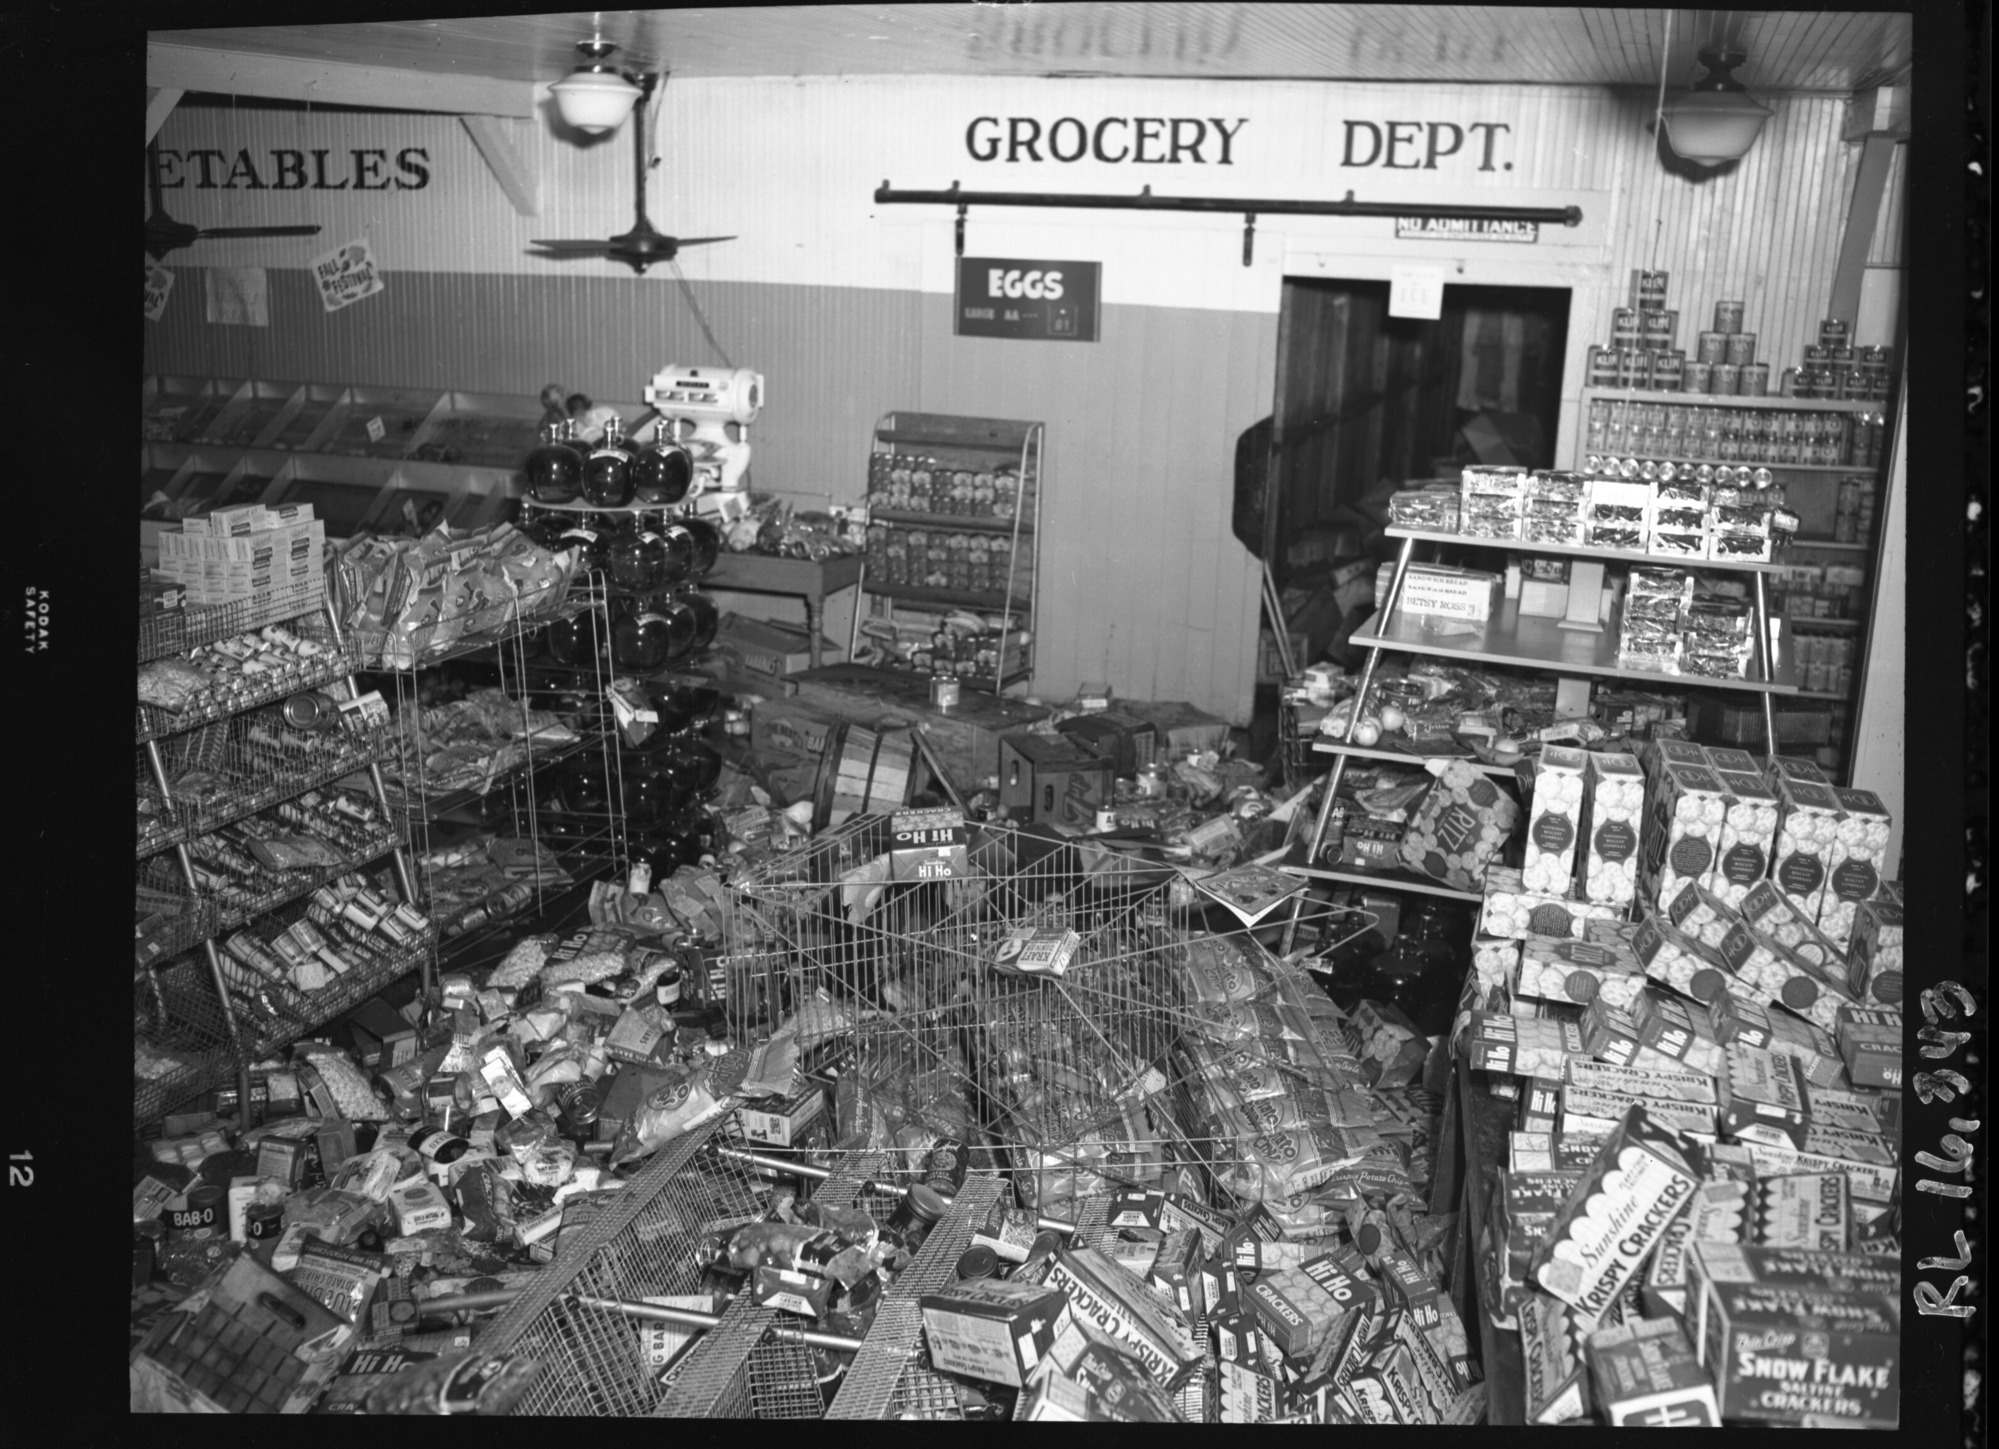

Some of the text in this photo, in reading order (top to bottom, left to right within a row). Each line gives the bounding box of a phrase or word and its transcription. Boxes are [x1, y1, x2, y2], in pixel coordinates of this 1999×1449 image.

[965, 116, 1513, 171] GROCERY DEPT.
[1399, 217, 1422, 230] NO
[318, 259, 340, 278] FALL
[988, 268, 1064, 299] EGGS
[1407, 597, 1467, 612] BETSY ROSS
[24, 586, 36, 654] SAFETY
[38, 590, 49, 650] KODAK
[896, 828, 954, 844] Hi Ho
[1437, 804, 1477, 851] RITZ
[1357, 841, 1384, 855] Hi Ho
[918, 864, 952, 878] Hi Ho
[1021, 951, 1051, 962] KRAFT
[1851, 1009, 1902, 1027] Hi H
[1859, 1042, 1902, 1053] CRAC
[1574, 1060, 1651, 1080] CRACKERS
[1653, 1072, 1708, 1088] KRISPY
[1652, 1100, 1708, 1118] KRISPY
[1814, 1098, 1869, 1115] KRISPY
[1822, 1129, 1879, 1145] KRISPY
[9, 1149, 34, 1187] 12
[1755, 1146, 1879, 1176] Sunshine KRISPY CRACKERS
[1359, 1169, 1386, 1185] Potato
[173, 1207, 213, 1227] BAB-O
[1578, 1194, 1641, 1270] Sunshine
[1575, 1259, 1628, 1318] KRISPY
[1618, 1174, 1691, 1257] CRACKERS
[302, 1271, 325, 1282] CHIPS
[1304, 1259, 1353, 1301] Hi Ho
[1912, 1229, 1978, 1318] RL
[1050, 1267, 1121, 1335] CRACKERS
[1255, 1284, 1304, 1326] CRACKERS
[1412, 1304, 1438, 1327] Hi Ho
[349, 1354, 380, 1374] Hi
[653, 1355, 665, 1374] IG
[1129, 1338, 1175, 1388] KRISPY
[1738, 1351, 1891, 1390] SNOW FLAKE
[1254, 1375, 1272, 1423] RACKERS
[1387, 1368, 1415, 1418] KRISPY
[1761, 1390, 1862, 1416] CRACKERS
[1355, 1388, 1377, 1423] KRISP
